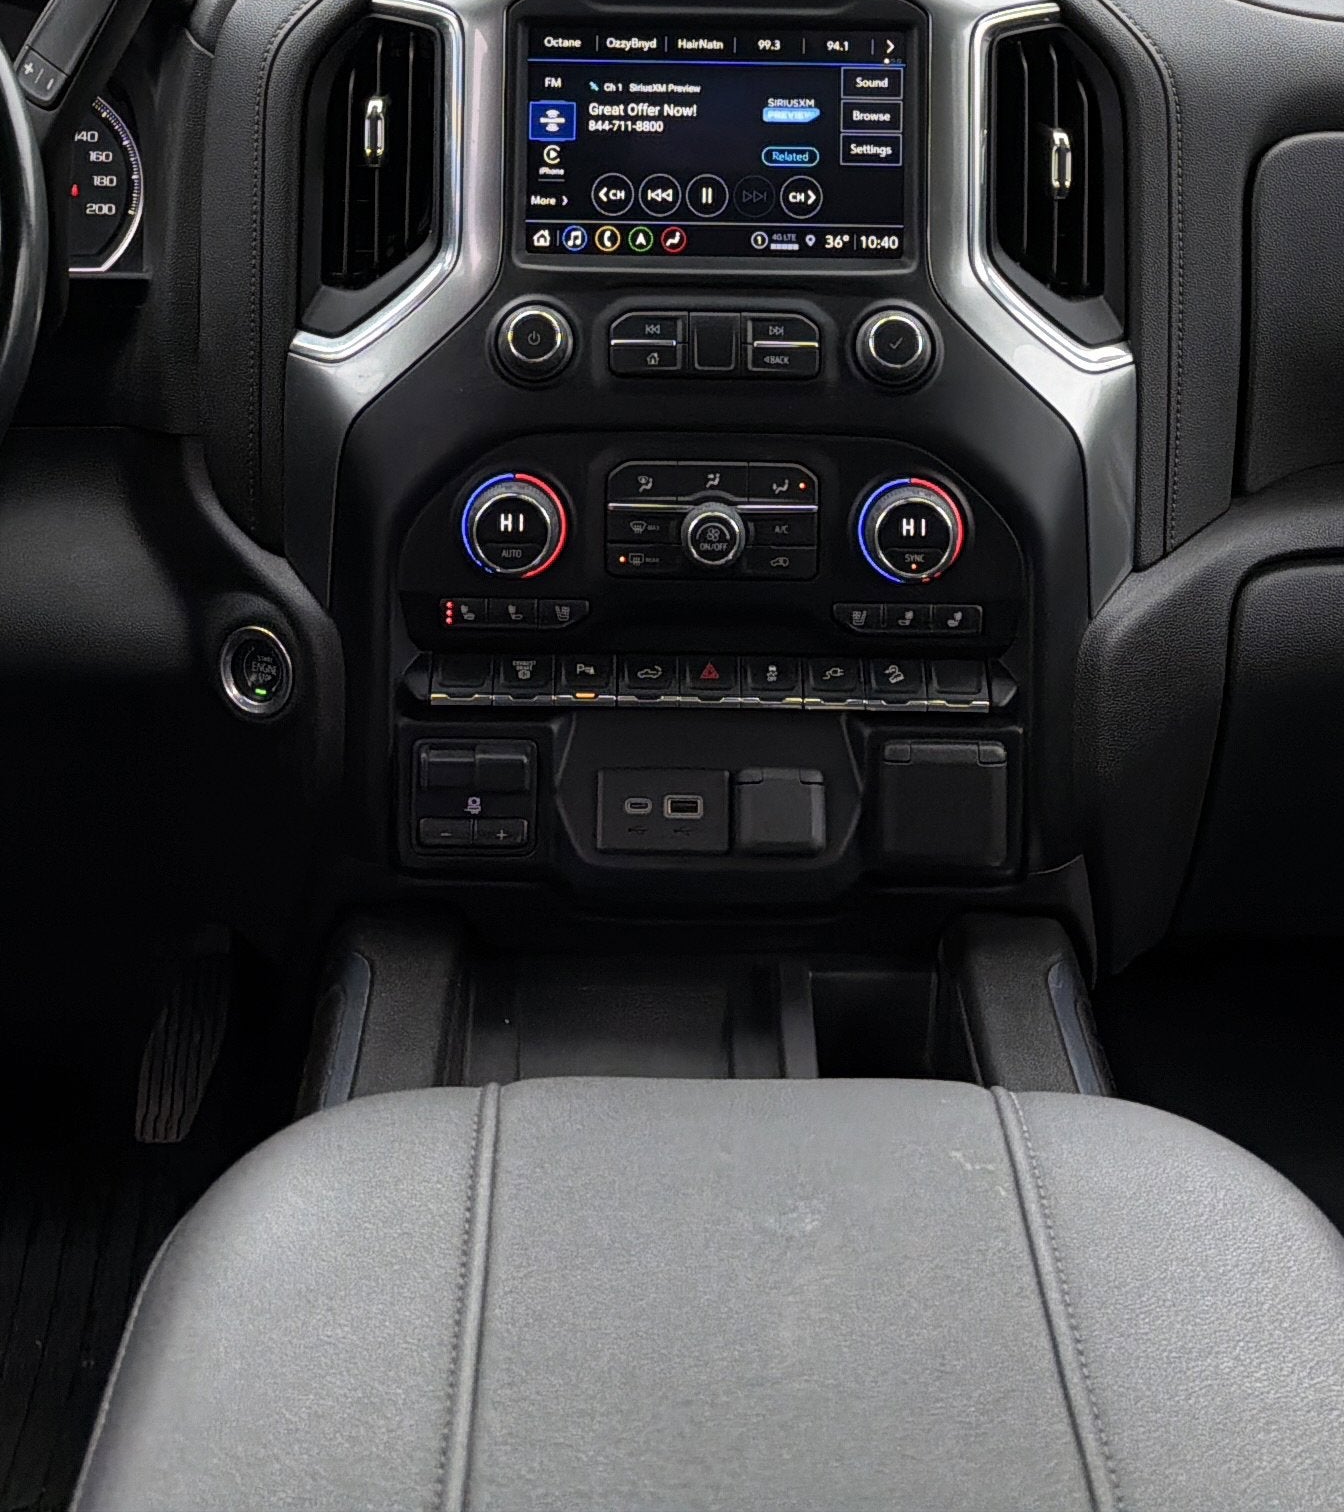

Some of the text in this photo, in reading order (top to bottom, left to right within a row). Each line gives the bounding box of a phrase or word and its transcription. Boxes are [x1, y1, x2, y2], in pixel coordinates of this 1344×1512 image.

[544, 36, 582, 49] Octane
[606, 37, 657, 51] OzzyBnyd
[677, 38, 724, 50] HairNatn
[757, 39, 781, 51] 99.3
[826, 40, 849, 52] 94.1
[544, 77, 562, 89] FM
[603, 83, 617, 92] Ch
[629, 83, 666, 93] SiriusXM
[667, 84, 702, 94] Preview
[855, 76, 889, 89] Sound
[767, 97, 816, 108] SIRIUSXM
[588, 102, 698, 117] Great Offer Now!
[852, 110, 891, 122] Browse
[587, 119, 664, 133] 844-711-8800
[89, 150, 113, 163] 160
[771, 151, 809, 162] Related
[850, 143, 893, 158] Settings
[538, 166, 565, 176] iPhone
[92, 175, 117, 187] 180
[530, 195, 557, 206] More
[608, 189, 625, 200] CH
[788, 191, 805, 203] CH
[85, 203, 116, 216] 200
[860, 235, 899, 249] 10:40
[770, 355, 790, 365] BACK
[499, 512, 525, 532] HI
[901, 517, 927, 537] HI
[774, 524, 789, 535] A/C
[699, 542, 728, 552] ON/OFF
[501, 549, 523, 559] AUTO
[904, 553, 925, 563] SYNC
[250, 661, 277, 676] ENGINE
